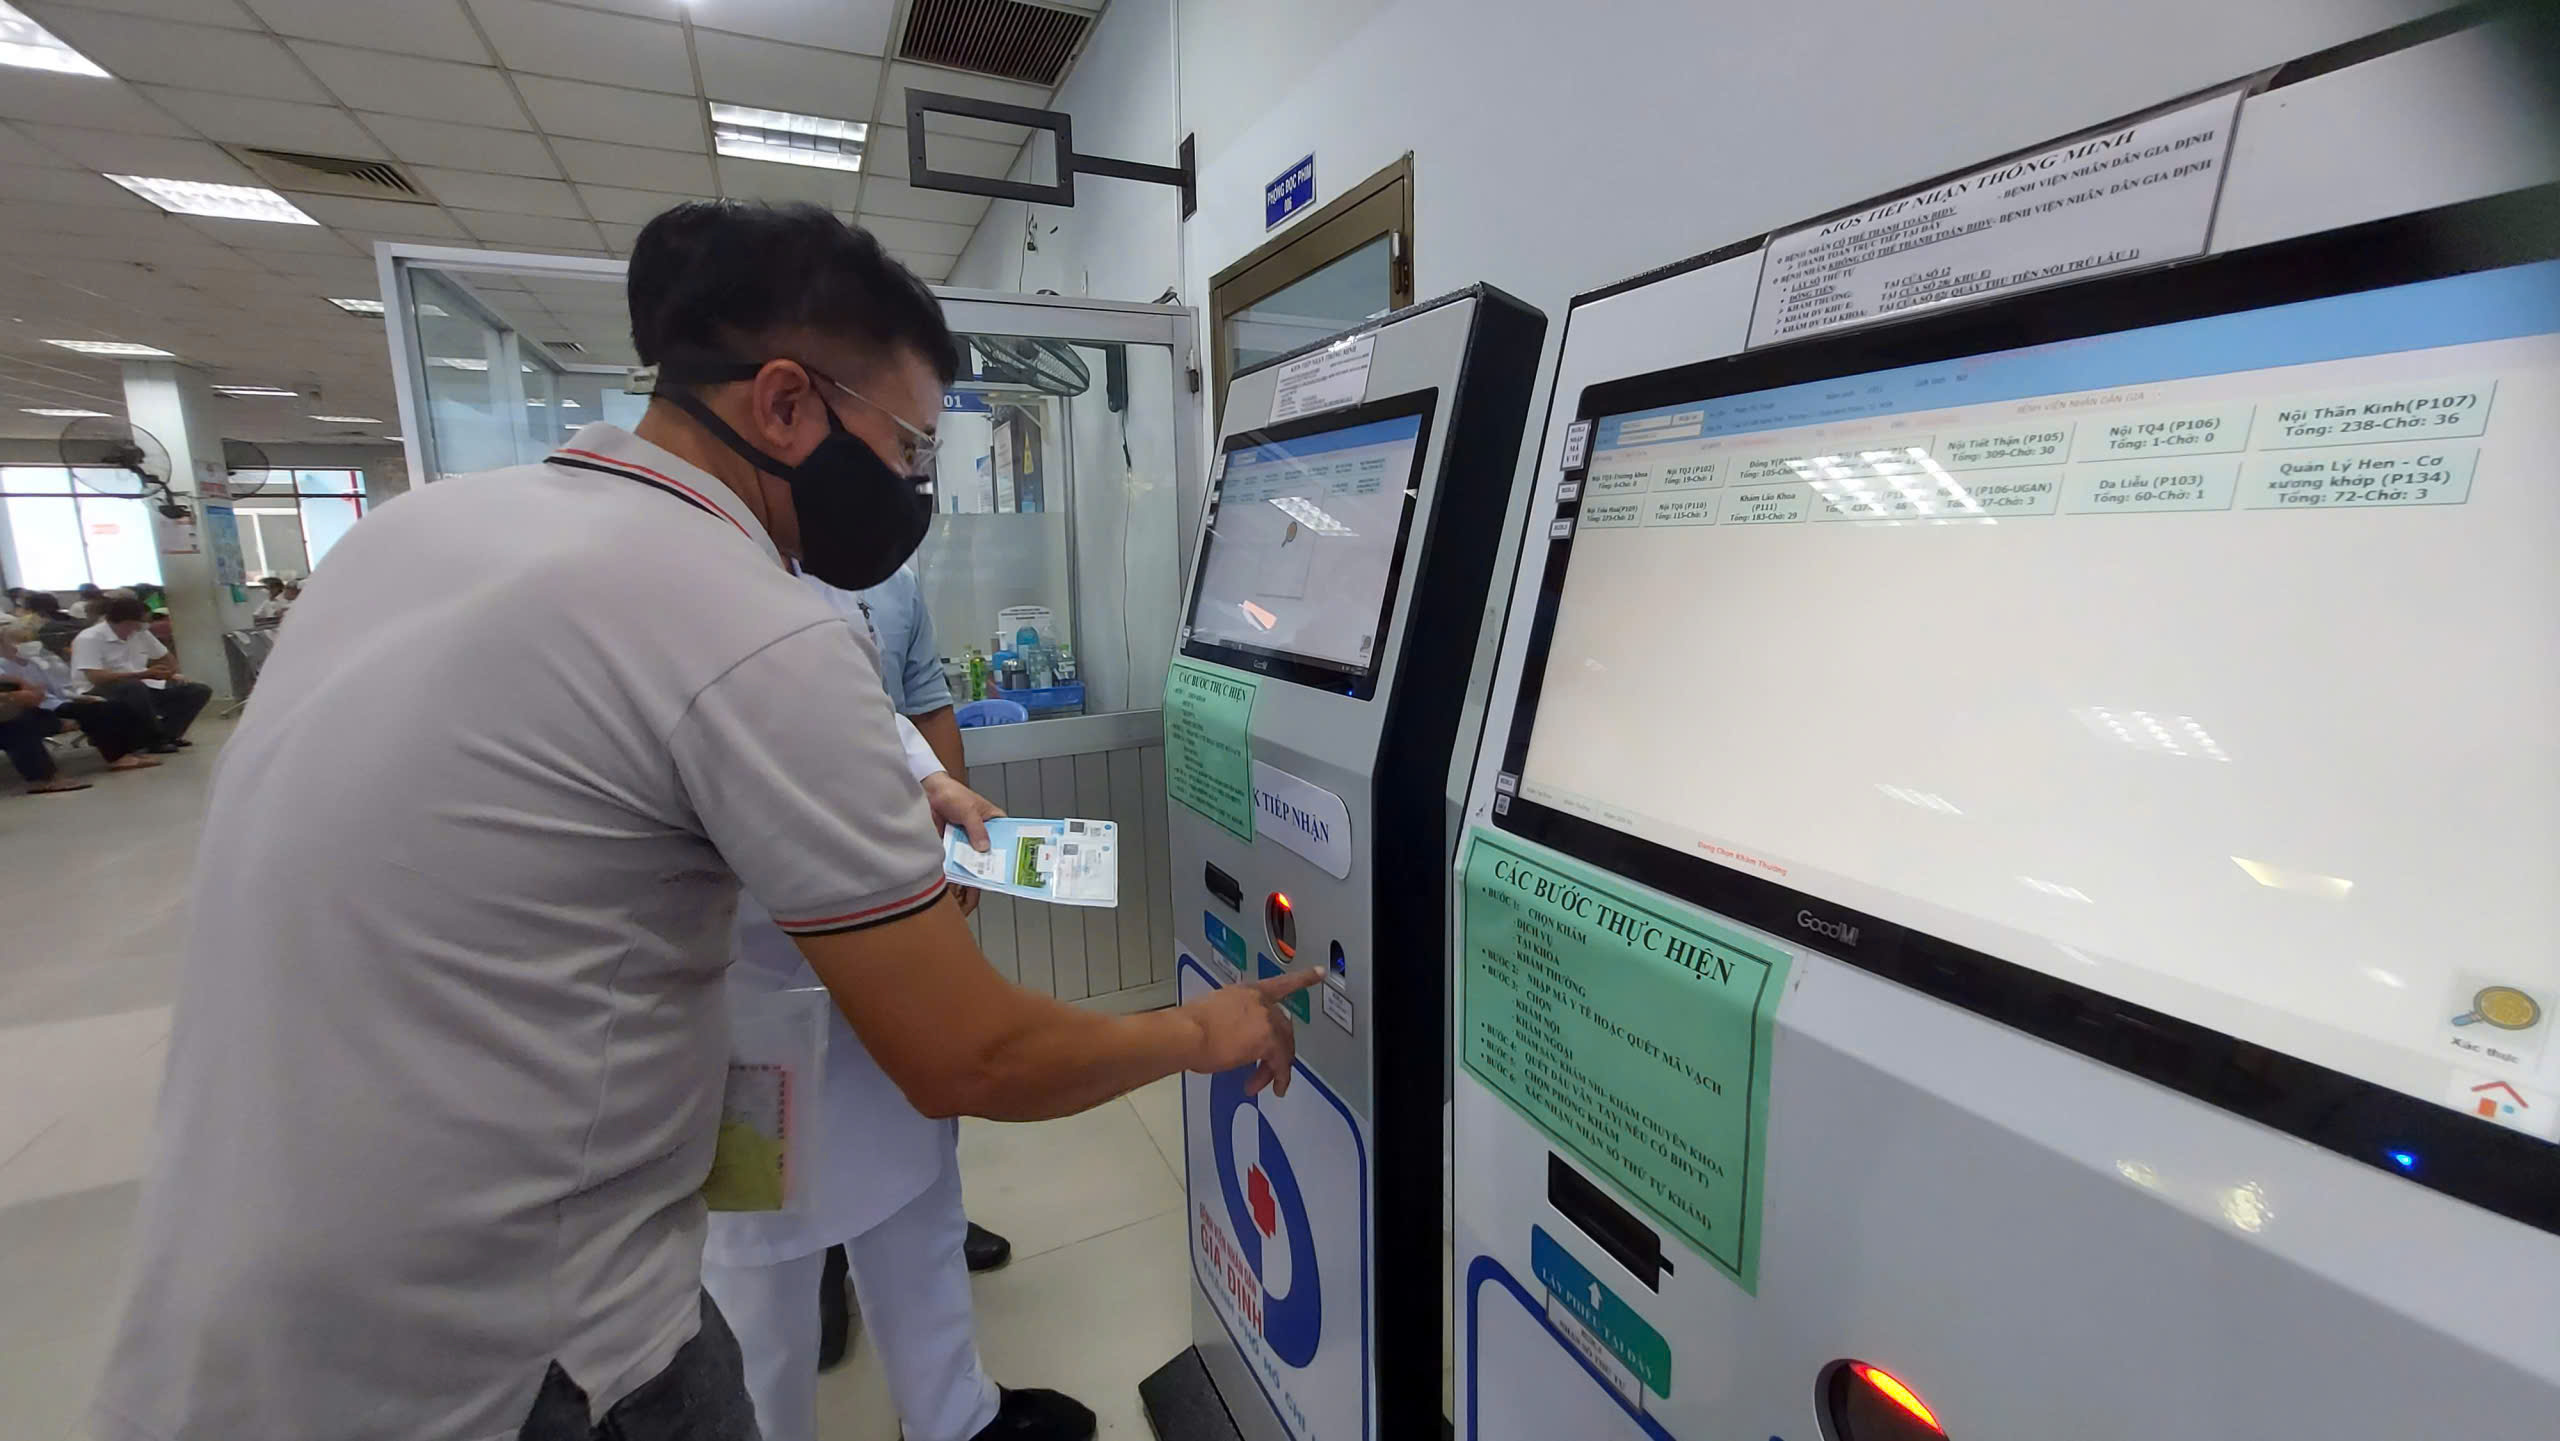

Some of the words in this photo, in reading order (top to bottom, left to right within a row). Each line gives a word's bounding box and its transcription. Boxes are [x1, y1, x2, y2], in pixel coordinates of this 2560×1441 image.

[2144, 143, 2170, 159] GIA
[1819, 218, 1862, 237] KIOS
[1976, 154, 2060, 189] THÔNG
[2063, 130, 2136, 163] MINH
[2142, 170, 2169, 185] GIA
[2279, 408, 2307, 423] Nội
[2363, 393, 2477, 416] Kinh(P107)
[2433, 413, 2460, 425] 36
[2110, 424, 2133, 438] Nội
[2169, 417, 2220, 433] (P106)
[2204, 433, 2214, 443] 0
[2358, 457, 2395, 470] Hen
[2099, 479, 2116, 490] Da
[2153, 474, 2204, 489] (P103)
[2381, 471, 2451, 487] (P134)
[2416, 488, 2428, 500] 3
[1262, 792, 1290, 822] TIẾP
[1292, 806, 1330, 844] NHẬN
[1494, 859, 1533, 891] CÁC
[1534, 877, 1593, 919] BƯỚC
[1596, 903, 1664, 951] THỰC
[1664, 935, 1736, 986] HIỆN
[1689, 1146, 1725, 1178] KHOA
[1200, 1222, 1222, 1276] GIA
[1227, 1263, 1263, 1337] ĐỊNH
